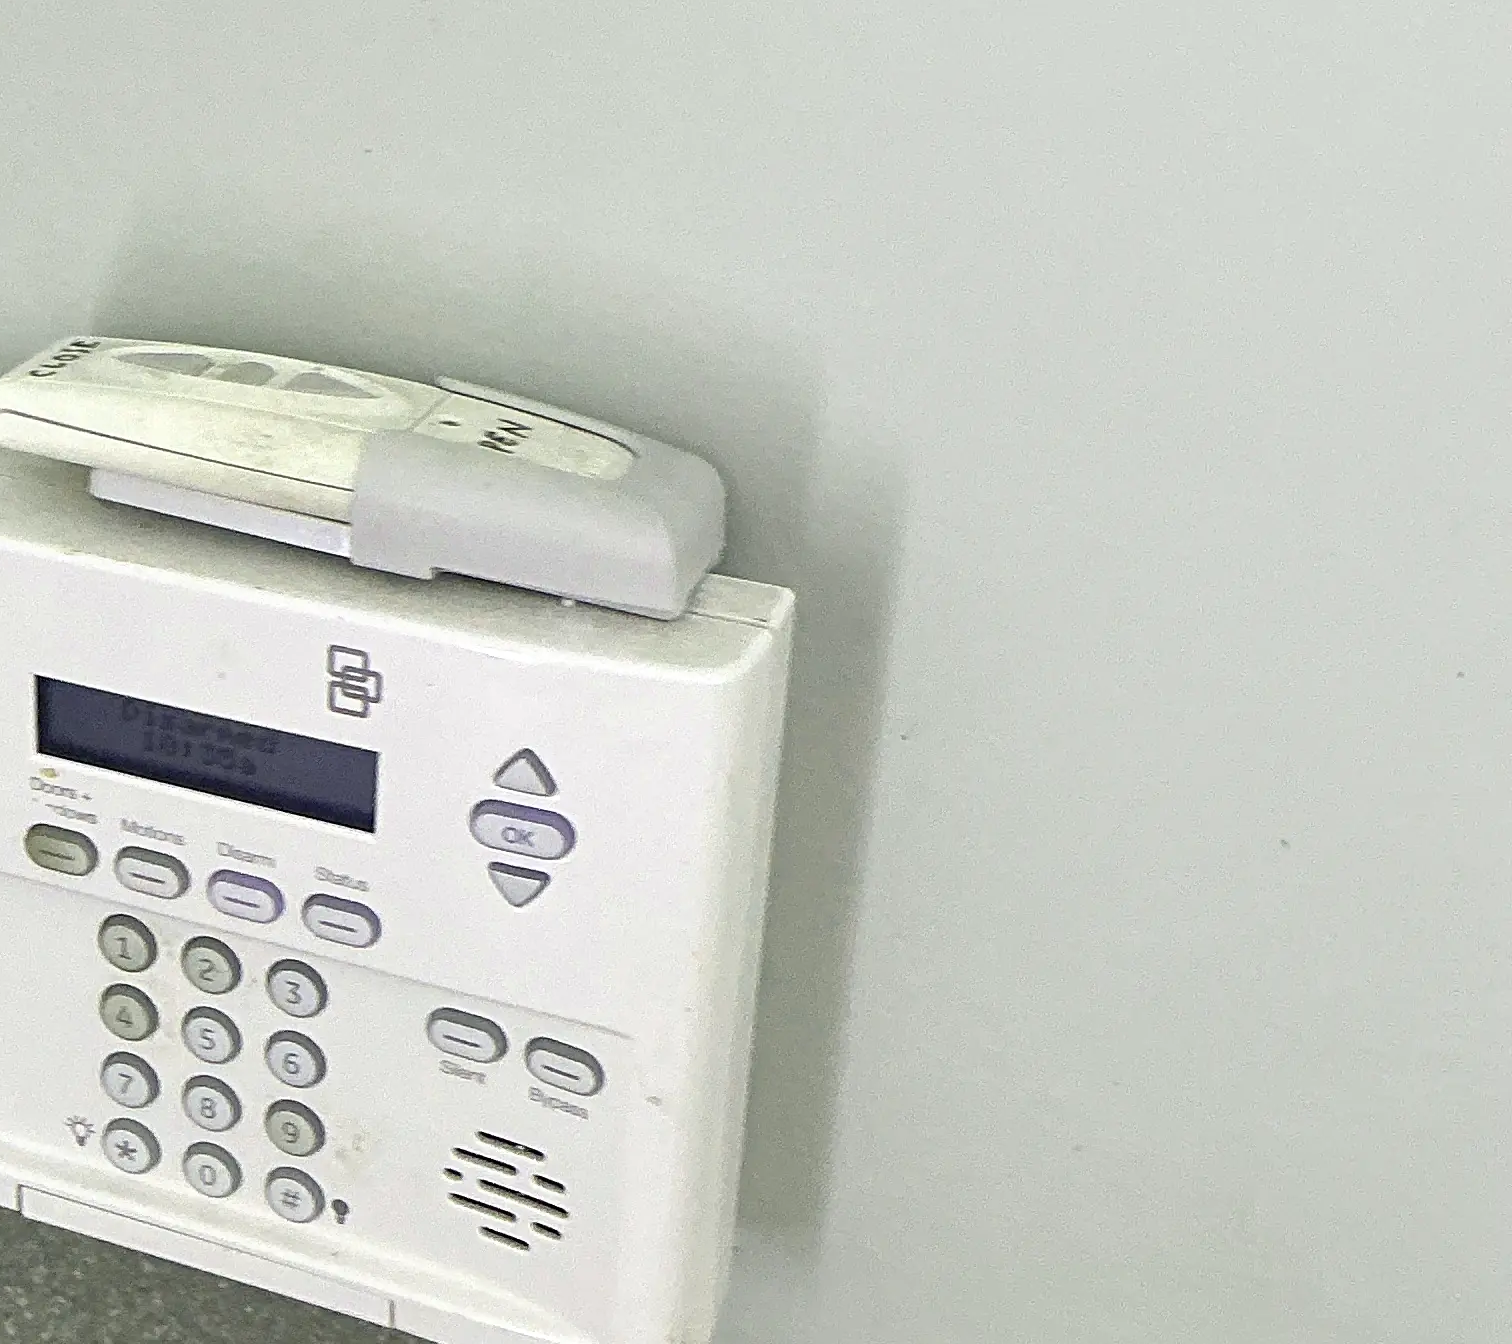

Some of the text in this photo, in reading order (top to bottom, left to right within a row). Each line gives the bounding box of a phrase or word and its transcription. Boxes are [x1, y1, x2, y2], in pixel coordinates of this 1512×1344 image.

[501, 826, 535, 848] OK
[114, 936, 132, 961] 1
[198, 958, 217, 982] 2
[284, 979, 303, 1005] 3
[115, 1005, 133, 1028] 4
[199, 1027, 217, 1051] 5
[281, 1051, 300, 1075] 6
[117, 1071, 134, 1095] 7
[199, 1096, 218, 1119] 8
[281, 1120, 301, 1144] 9
[198, 1164, 218, 1186] 0
